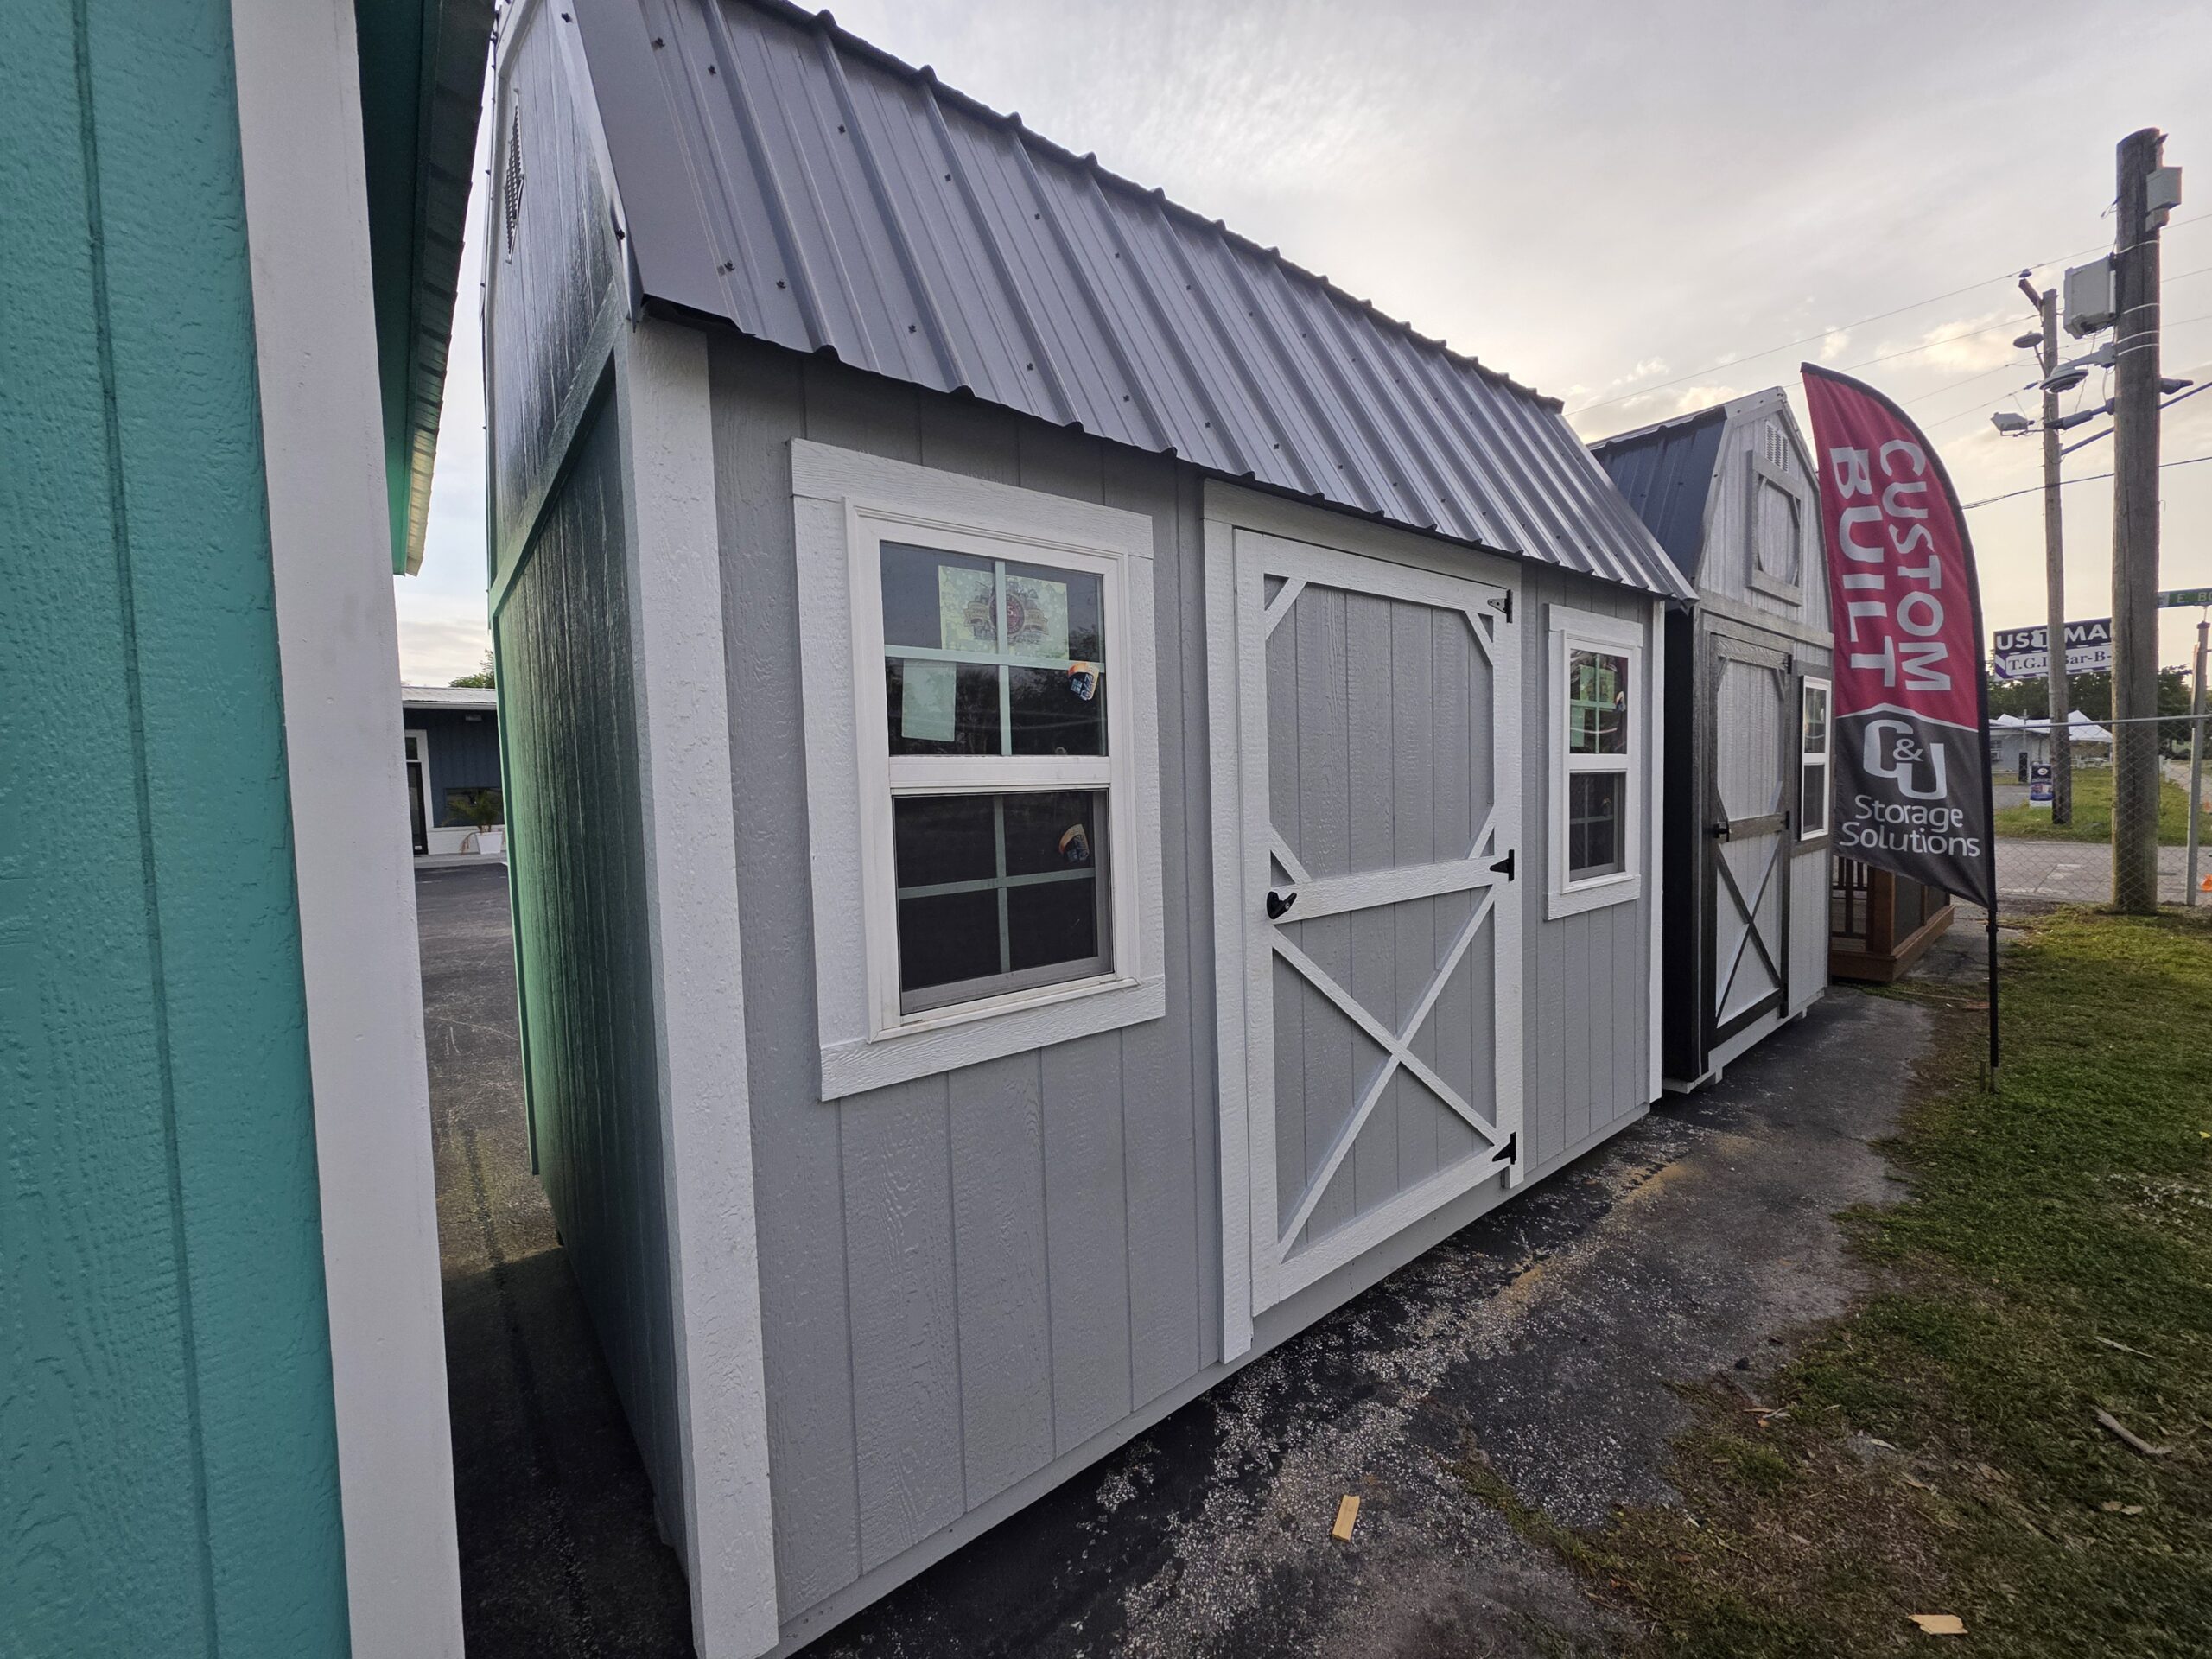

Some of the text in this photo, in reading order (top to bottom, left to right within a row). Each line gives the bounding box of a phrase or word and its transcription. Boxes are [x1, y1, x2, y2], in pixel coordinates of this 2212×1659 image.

[1829, 446, 1896, 688] BUILT
[1878, 439, 1952, 691] CUSTOM
[1997, 632, 2030, 651] US
[2063, 622, 2112, 644] MA
[2007, 650, 2112, 671] T.G.I ar-B-
[1854, 794, 1964, 834] Storage
[1839, 821, 1981, 858] Solutions
